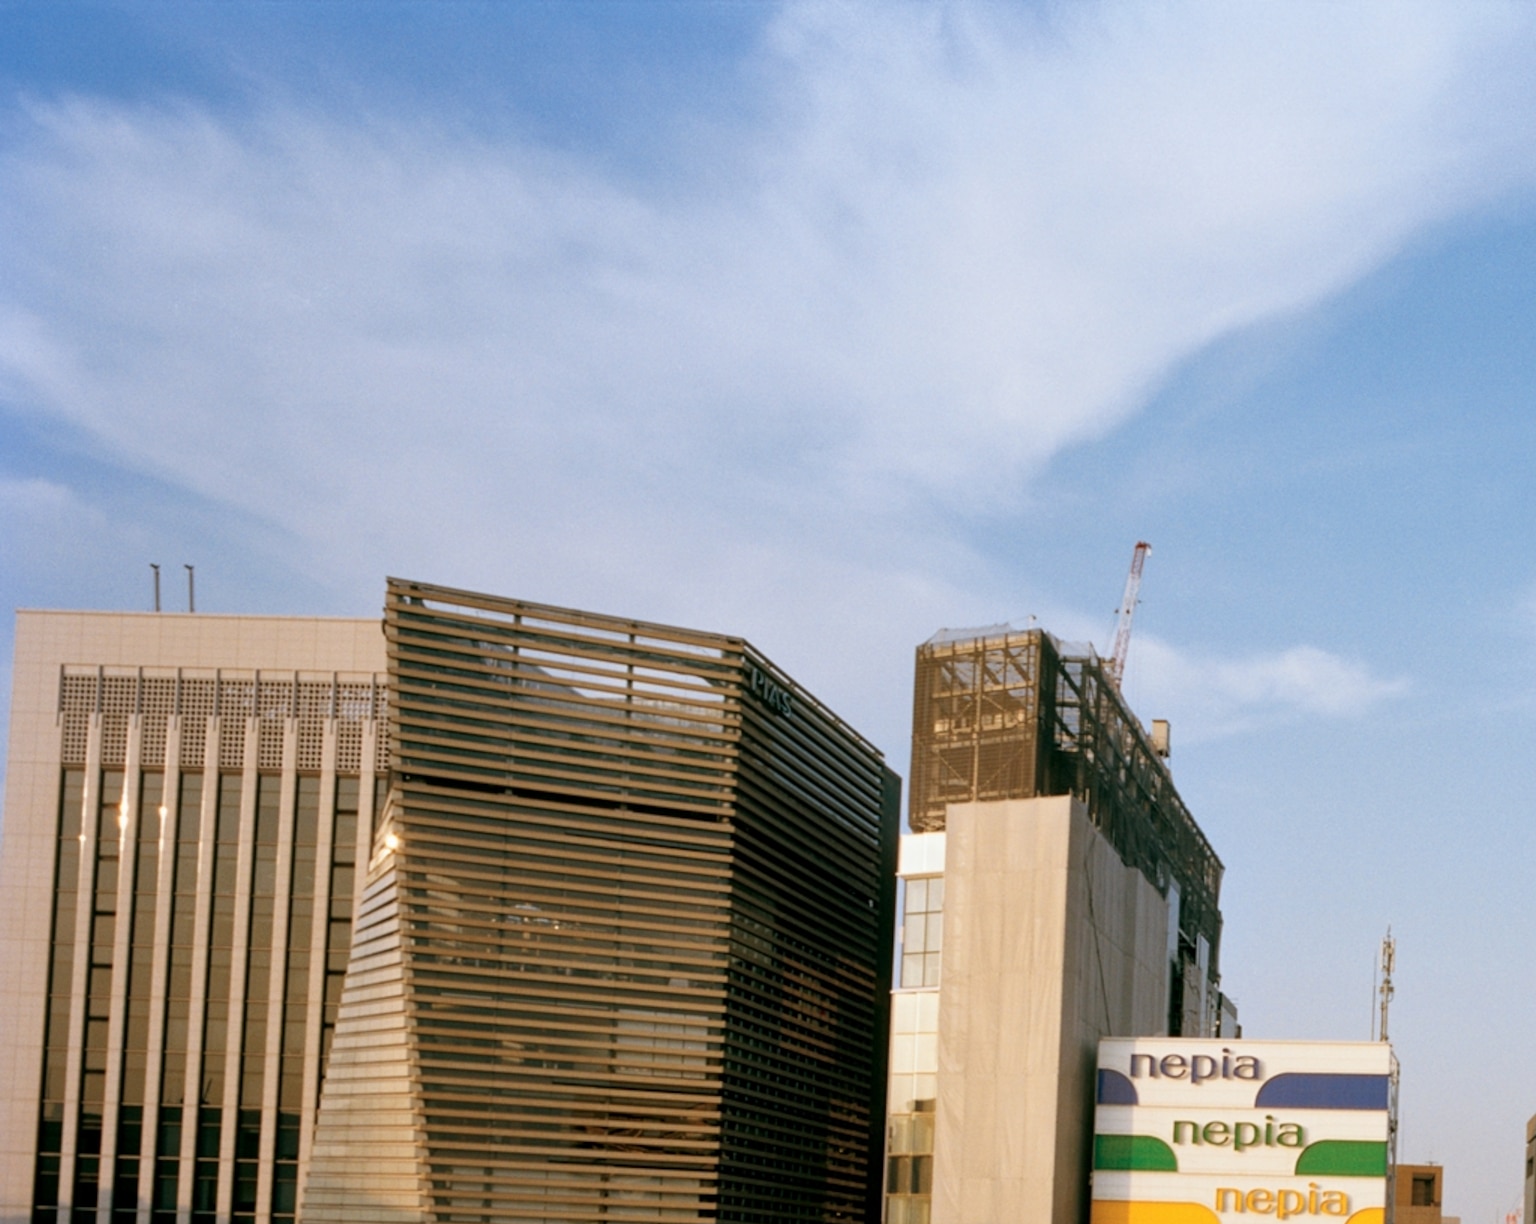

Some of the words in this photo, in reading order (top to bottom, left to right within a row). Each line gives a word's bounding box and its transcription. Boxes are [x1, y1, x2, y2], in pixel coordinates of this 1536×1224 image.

[751, 668, 792, 717] PIAS
[1130, 1047, 1261, 1084] nepia
[1172, 1114, 1306, 1151] nepia
[1215, 1182, 1350, 1220] nepia
